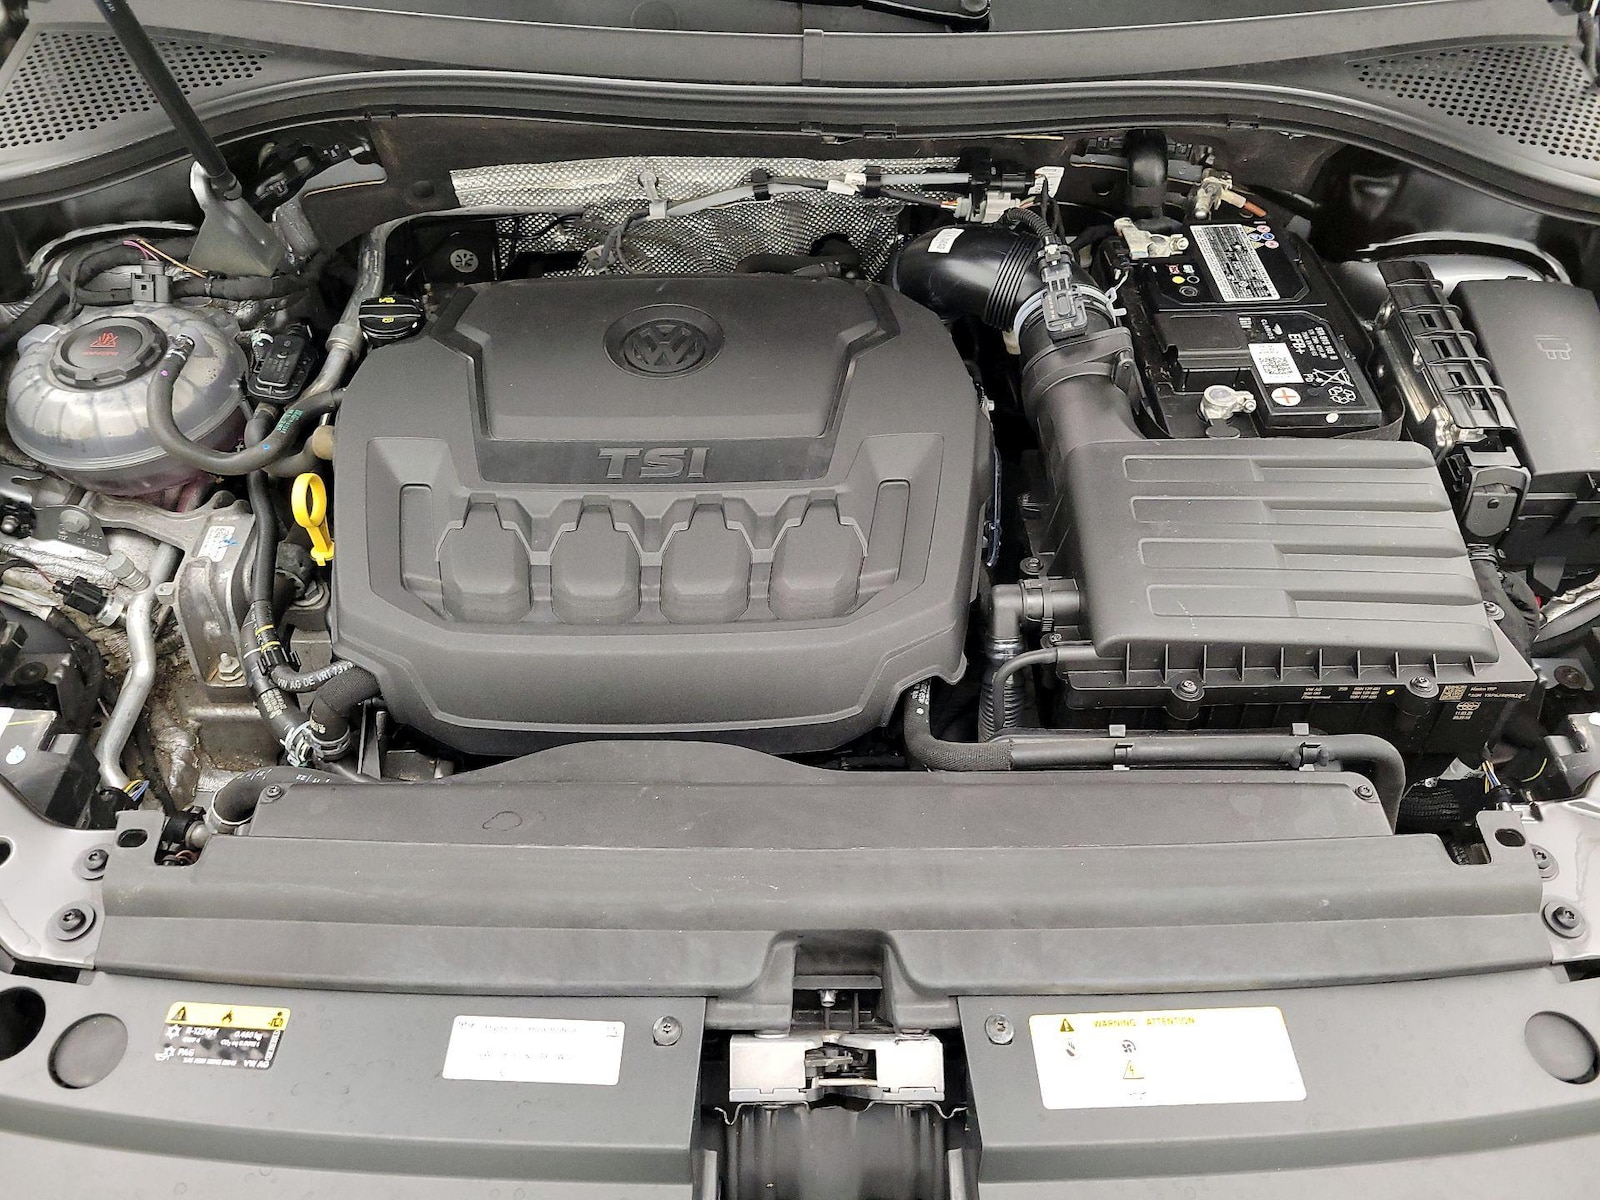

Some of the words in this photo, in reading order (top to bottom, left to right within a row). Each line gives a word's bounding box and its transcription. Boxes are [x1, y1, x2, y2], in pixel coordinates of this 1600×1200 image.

[1287, 333, 1307, 355] EFB+
[598, 447, 710, 479] TSI
[1093, 1018, 1136, 1028] WARNING
[1146, 1016, 1195, 1026] ATTENTION
[176, 1047, 196, 1057] PAG
[243, 1059, 256, 1068] VW
[255, 1059, 270, 1069] AG
